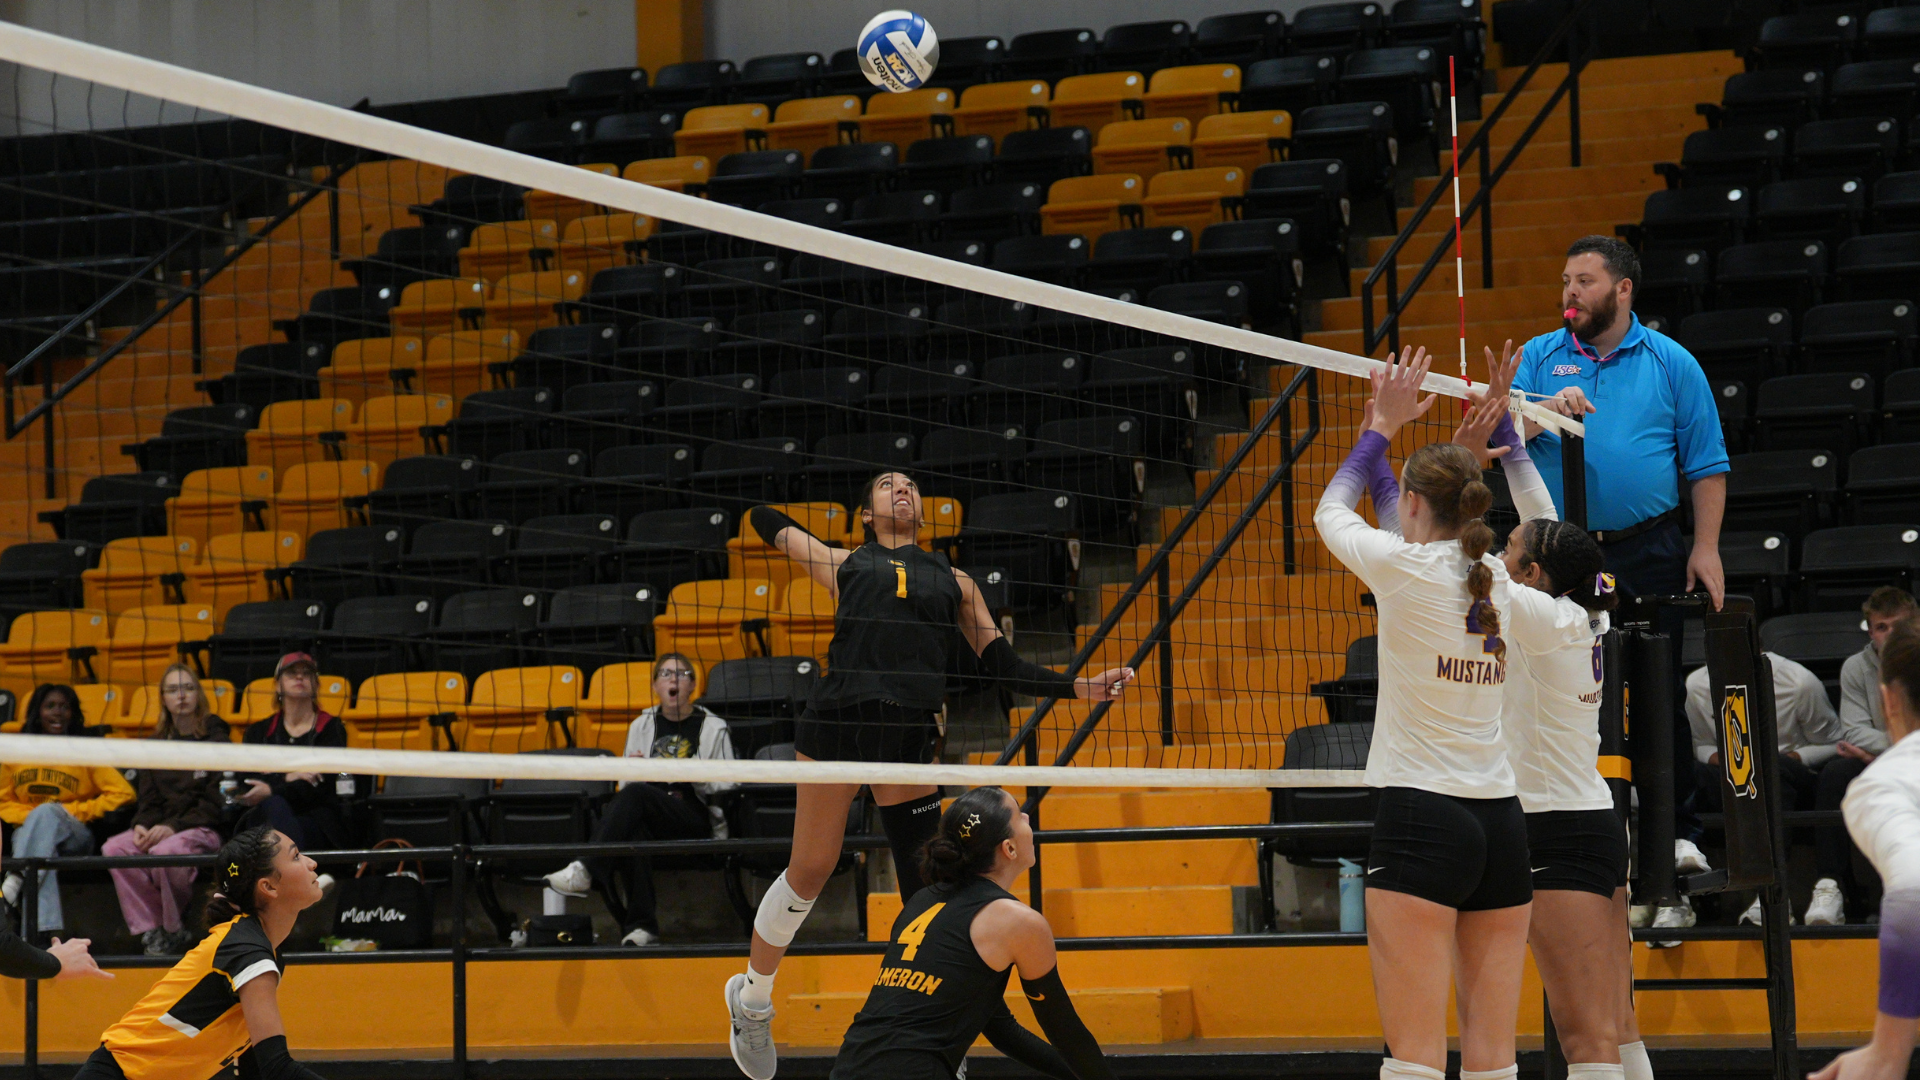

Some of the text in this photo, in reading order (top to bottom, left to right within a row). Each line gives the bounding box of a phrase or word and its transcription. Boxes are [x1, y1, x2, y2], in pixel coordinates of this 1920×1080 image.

[873, 56, 904, 91] molten
[885, 52, 916, 84] NCAA
[895, 567, 908, 598] 1
[896, 902, 947, 962] 4
